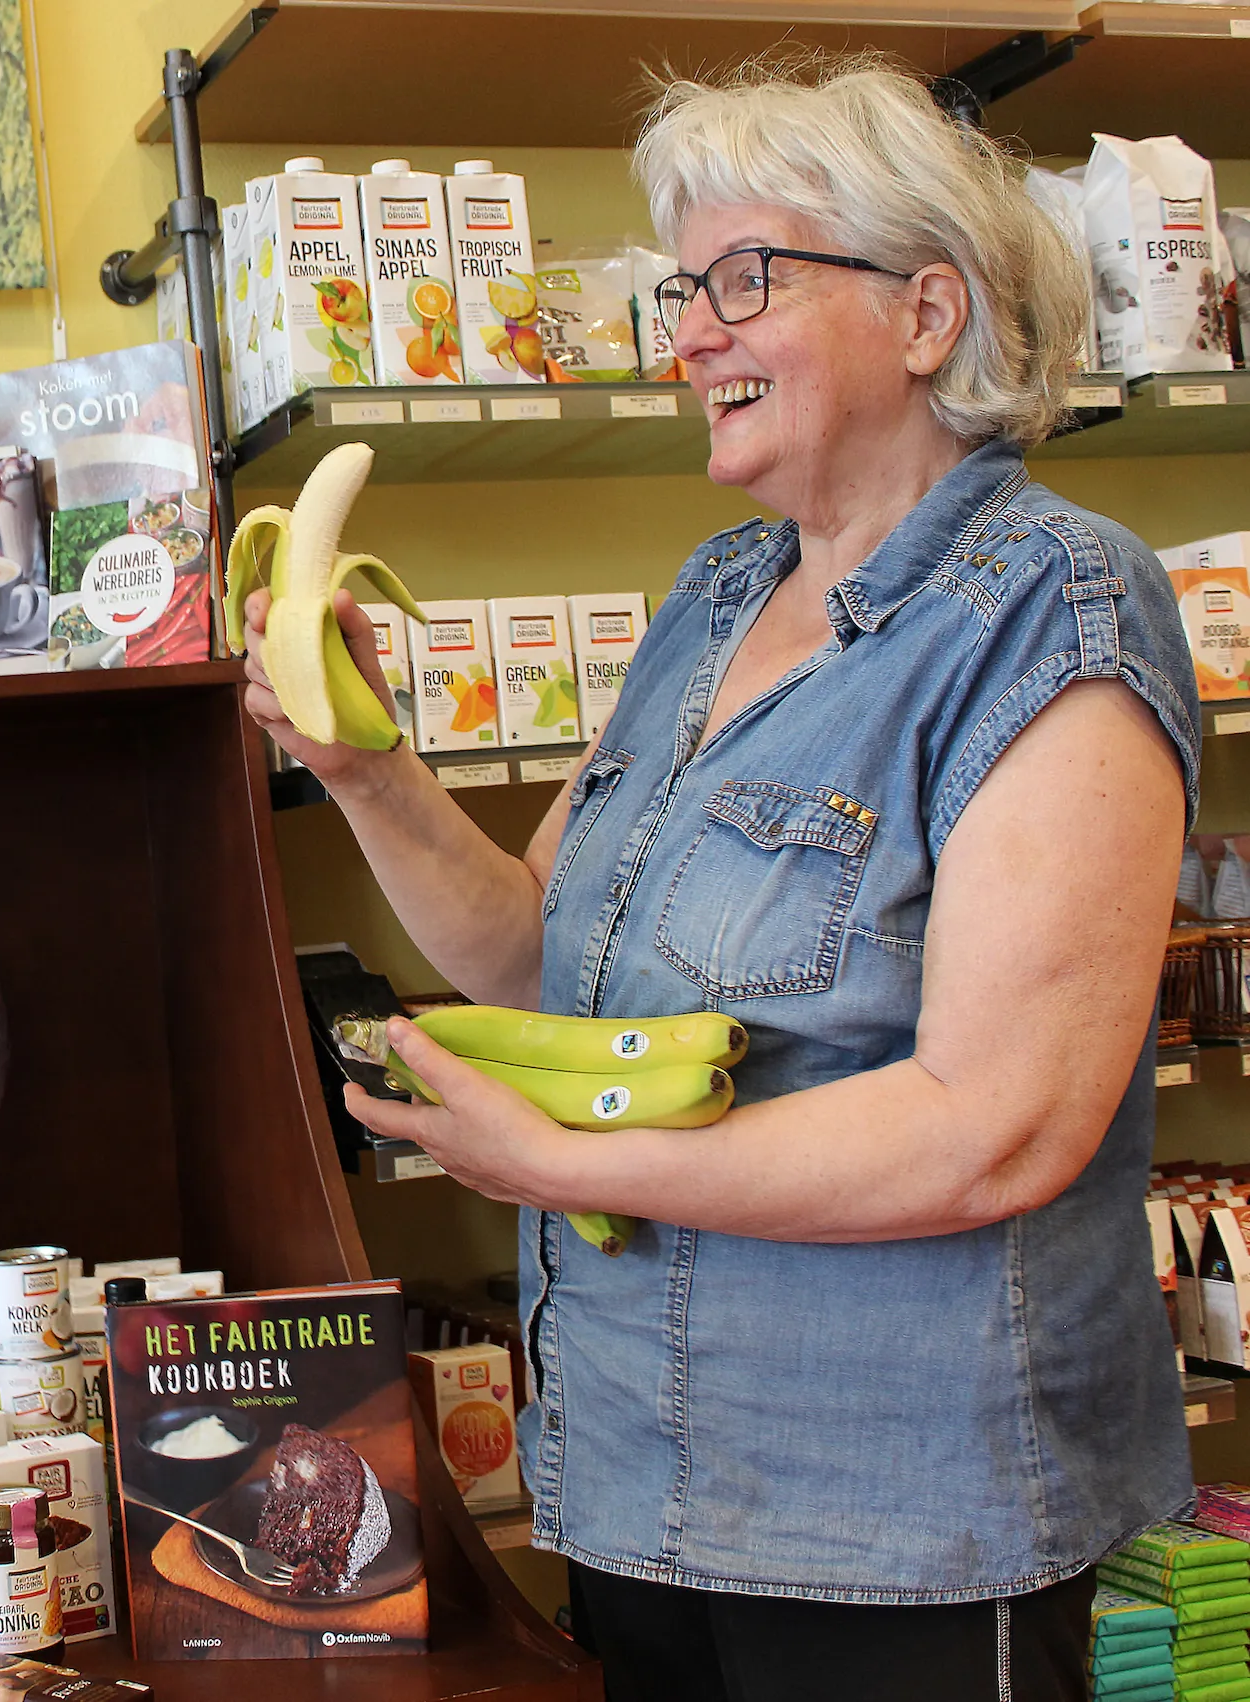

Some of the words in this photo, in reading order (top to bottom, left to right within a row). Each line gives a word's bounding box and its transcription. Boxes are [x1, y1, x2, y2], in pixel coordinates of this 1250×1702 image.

[290, 240, 350, 263] APPEL,
[375, 238, 438, 258] SINAAS
[458, 239, 522, 257] TROPISCH
[289, 265, 322, 276] LEMON
[334, 264, 357, 276] LIME
[379, 259, 430, 280] APPEL
[461, 259, 504, 278] FRUIT
[39, 375, 82, 396] Koken
[20, 390, 140, 437] stoom
[98, 548, 158, 573] CULINAIRE
[93, 567, 162, 592] WERELDREIS
[434, 633, 469, 641] ORIGINAL
[516, 629, 550, 638] ORIGINAL
[1203, 624, 1242, 637] ROOIBOS
[423, 670, 454, 686] ROOI
[506, 665, 547, 682] GREEN
[507, 683, 525, 694] TEA
[588, 678, 613, 689] BLEND
[425, 687, 442, 698] BOS
[7, 1303, 50, 1321] KOKOS
[12, 1321, 44, 1336] MELK
[145, 1323, 197, 1357] HET
[208, 1312, 376, 1355] FAIRTRADE
[148, 1357, 293, 1395] KOOKBOEK
[232, 1395, 262, 1409] Sophie
[38, 1467, 60, 1479] FAIR
[14, 1579, 44, 1591] ORIGINAL
[182, 1638, 222, 1648] LANNOO
